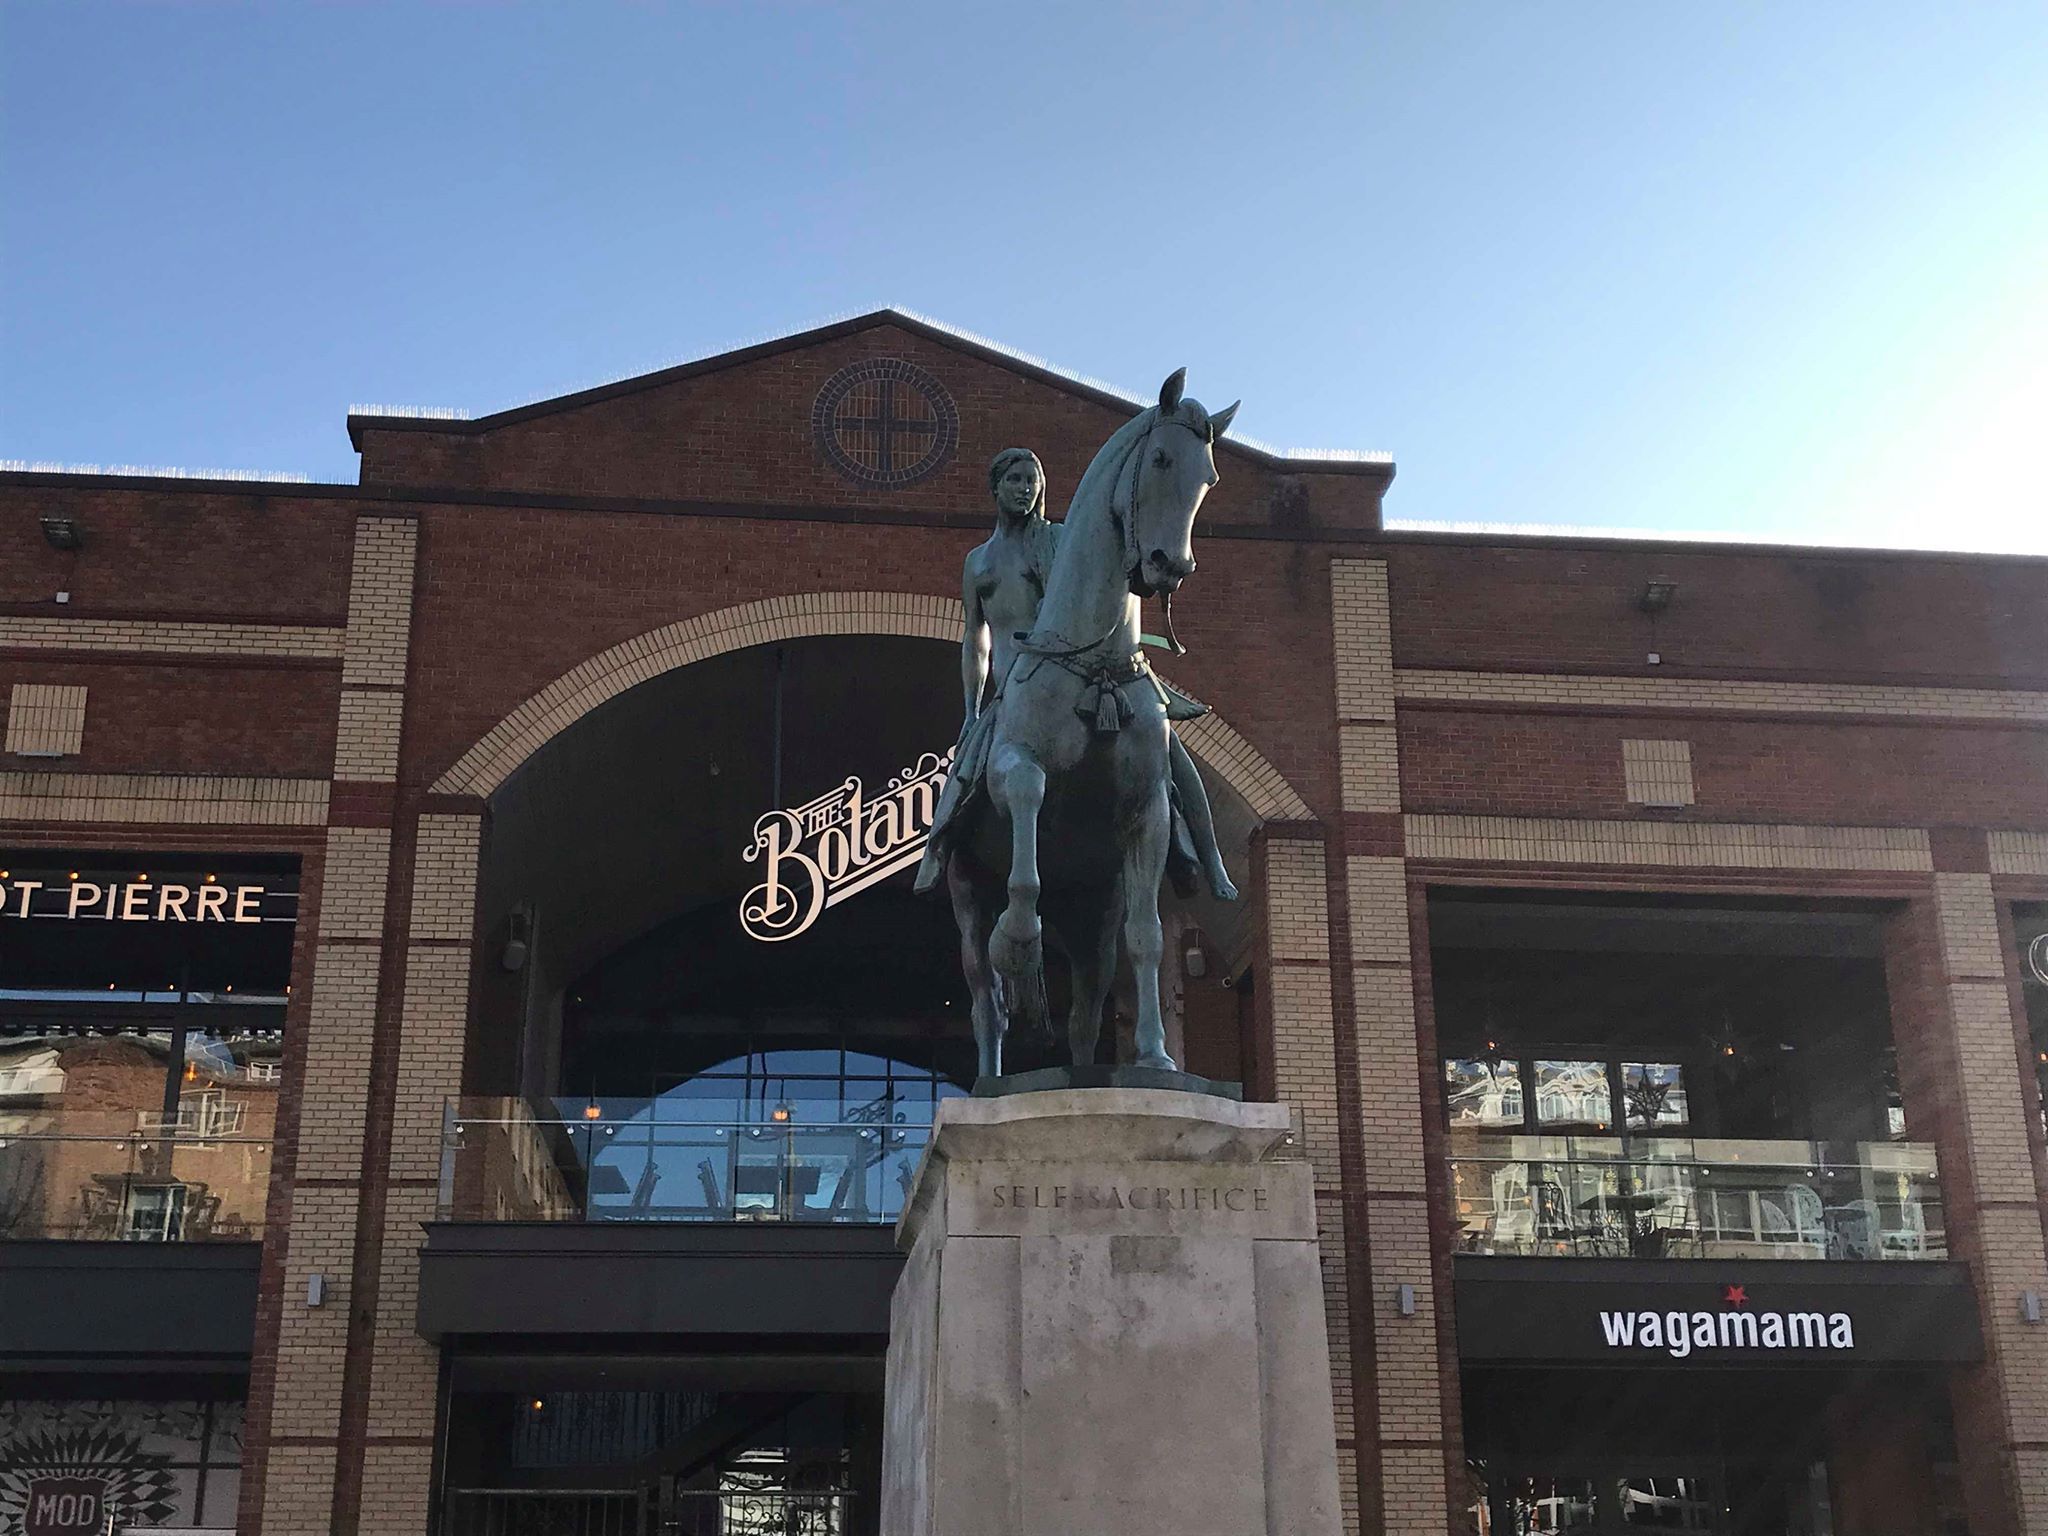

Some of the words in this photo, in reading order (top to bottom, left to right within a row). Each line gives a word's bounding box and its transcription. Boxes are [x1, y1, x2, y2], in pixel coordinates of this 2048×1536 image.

[801, 798, 846, 839] THE
[0, 881, 43, 919] T
[67, 882, 265, 923] PIERRE
[992, 1185, 1272, 1212] SELF-SACRIFICE
[1600, 1311, 1855, 1358] wagamama
[35, 1494, 96, 1526] MOD
